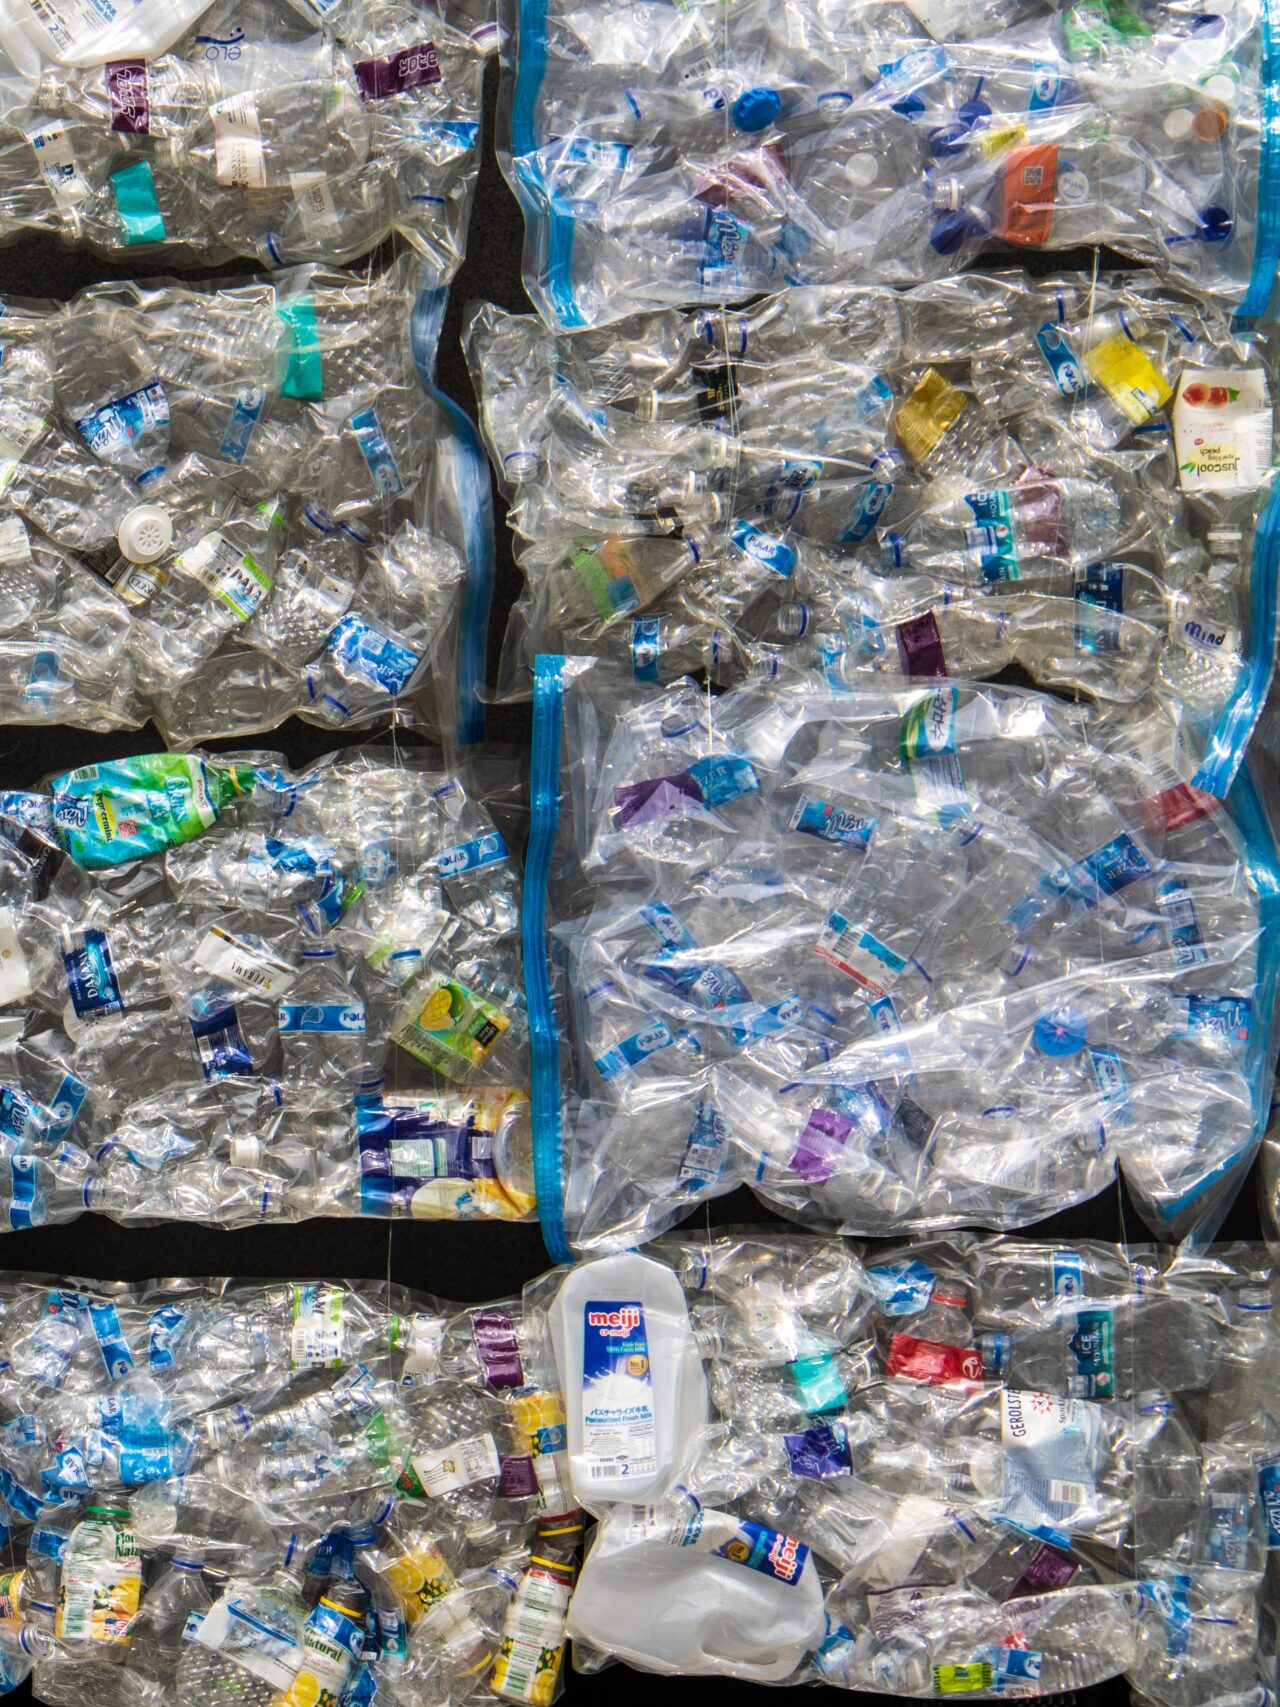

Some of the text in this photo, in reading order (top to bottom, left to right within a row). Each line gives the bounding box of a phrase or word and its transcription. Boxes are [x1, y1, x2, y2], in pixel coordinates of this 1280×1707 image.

[48, 25, 59, 35] 2
[713, 214, 739, 266] Mizu
[91, 408, 126, 452] Mizu
[1198, 446, 1222, 456] peach
[747, 534, 776, 556] POLAR
[1184, 620, 1226, 647] Mind
[165, 778, 188, 822] GREEN
[94, 789, 117, 843] Peppermint
[822, 811, 868, 836] Mizu
[79, 951, 98, 999] DASANI
[1197, 1004, 1244, 1037] Mizu
[637, 1030, 667, 1048] POLAR
[588, 1308, 639, 1329] meiji
[600, 1329, 630, 1339] CP-meiji
[1082, 1334, 1091, 1357] ICE
[1093, 1320, 1101, 1367] MOUNTAIN
[584, 1415, 622, 1424] Pasteurized
[624, 1414, 641, 1423] Fresh
[620, 1463, 629, 1476] 2
